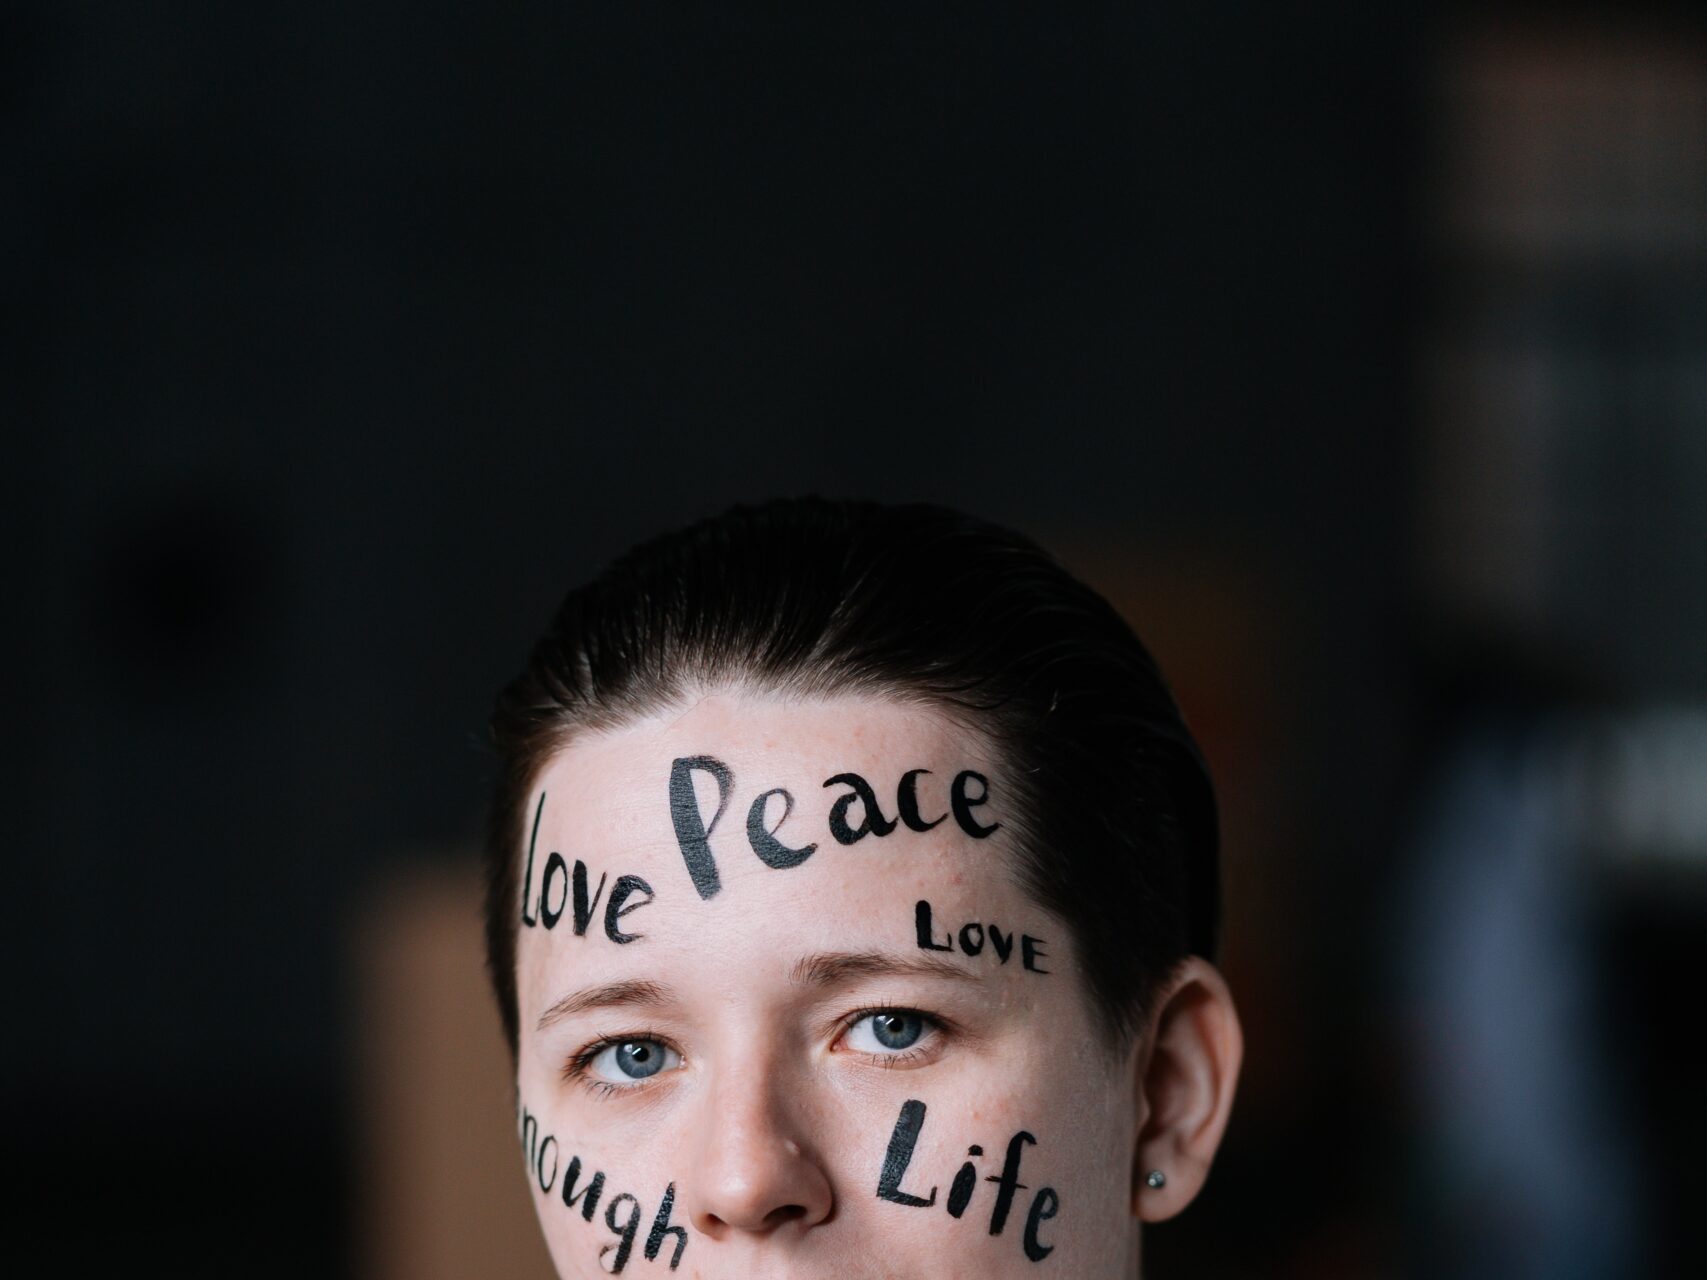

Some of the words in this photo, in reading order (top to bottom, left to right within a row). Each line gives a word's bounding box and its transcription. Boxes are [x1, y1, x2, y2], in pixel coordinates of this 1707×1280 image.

[669, 755, 1000, 900] Peace
[914, 900, 1049, 974] LOVE
[519, 1105, 689, 1275] nough
[876, 1099, 1060, 1263] Life
